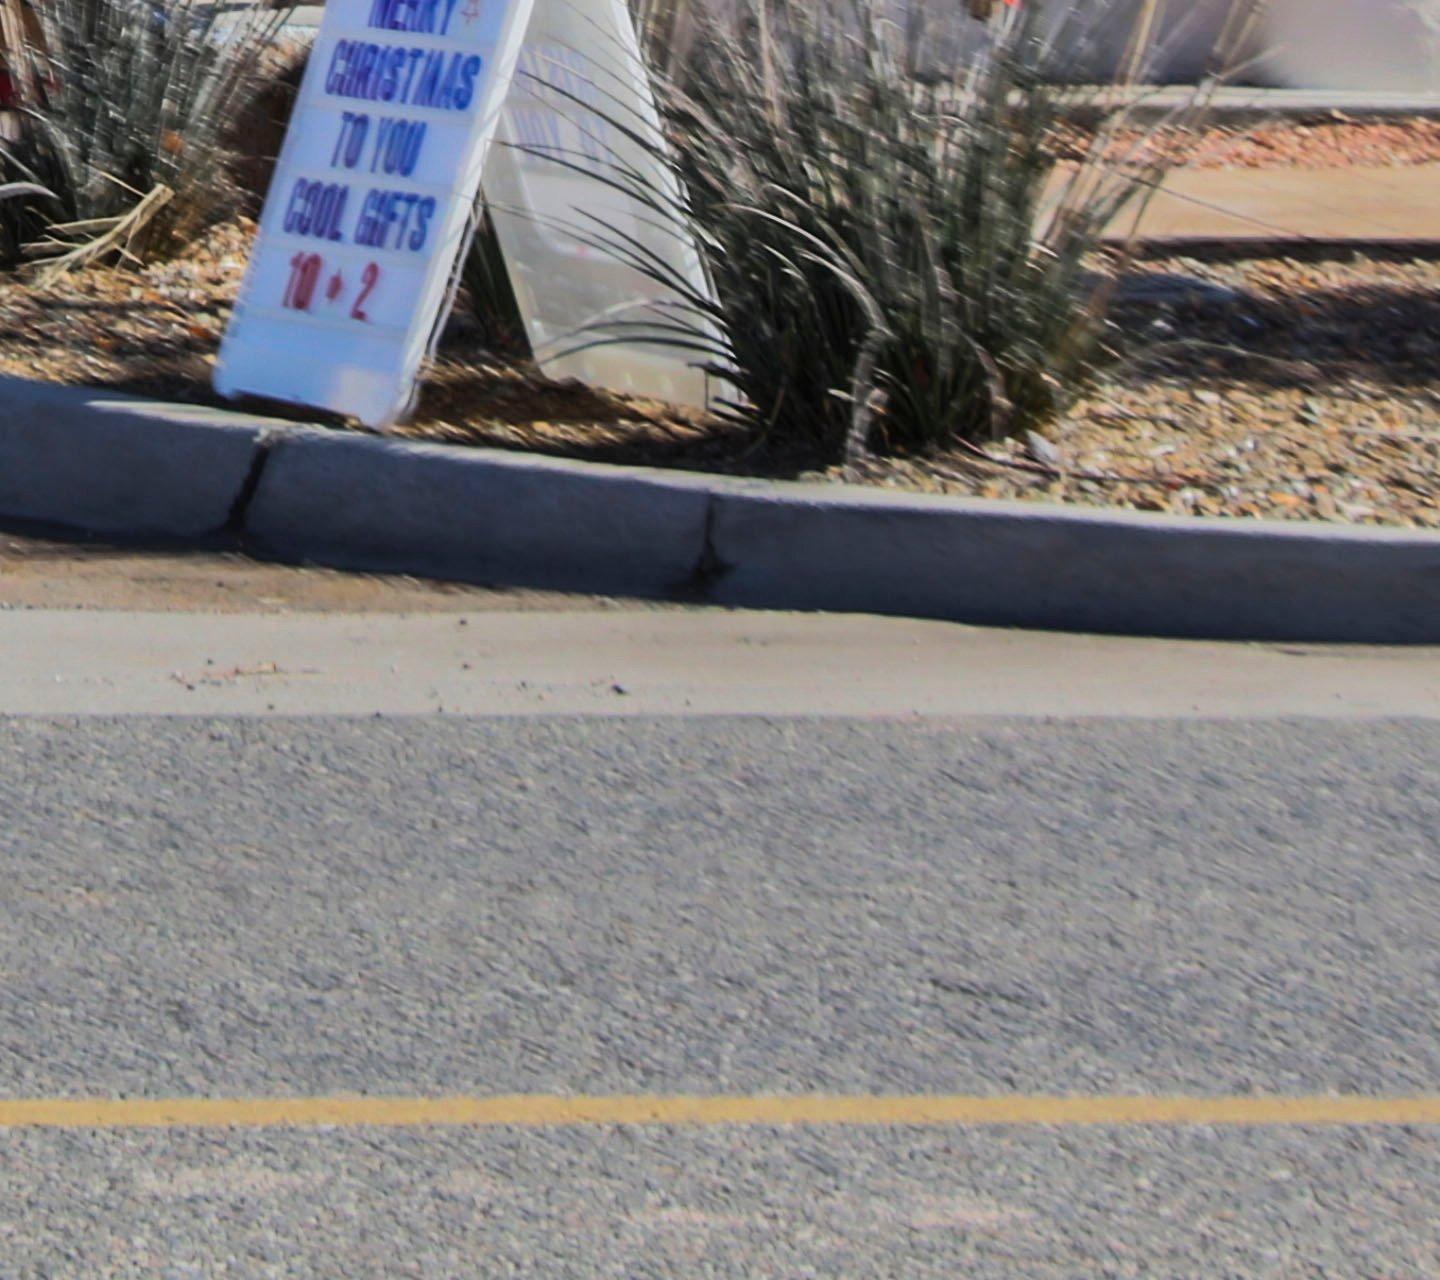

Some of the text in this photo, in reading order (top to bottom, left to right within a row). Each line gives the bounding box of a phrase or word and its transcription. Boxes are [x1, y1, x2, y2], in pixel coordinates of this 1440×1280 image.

[324, 38, 482, 111] CHRISTMAS
[330, 110, 427, 178] TO YOU
[282, 176, 437, 252] COOL GIFTS
